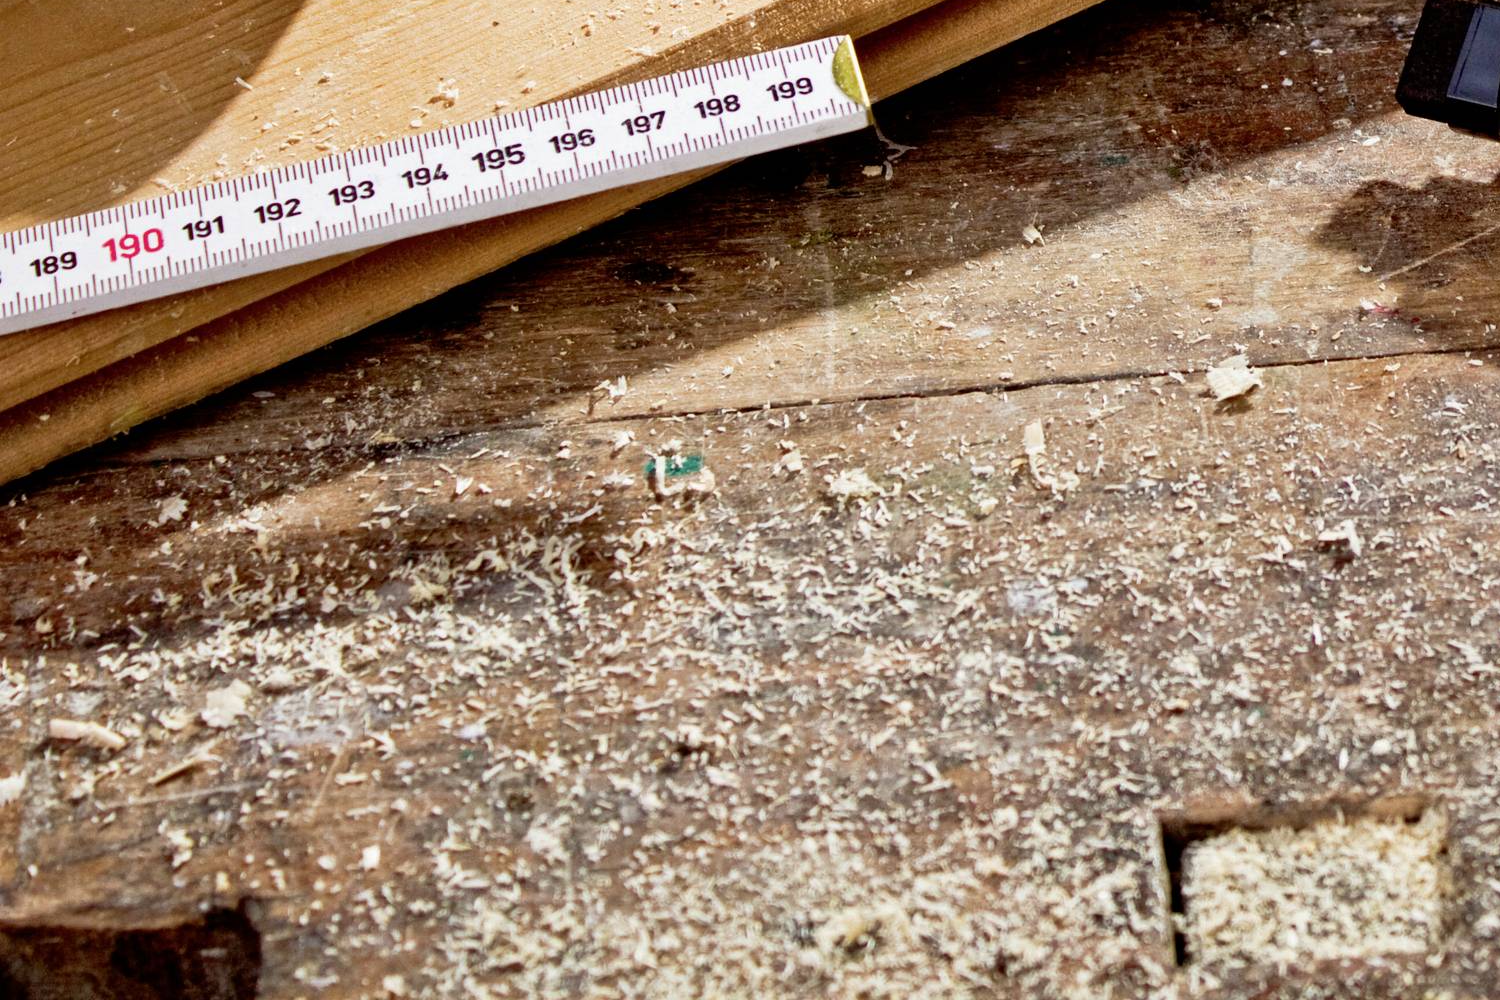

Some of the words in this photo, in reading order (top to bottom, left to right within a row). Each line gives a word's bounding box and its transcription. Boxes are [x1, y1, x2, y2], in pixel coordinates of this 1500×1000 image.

[30, 251, 78, 277] 189
[102, 228, 165, 262] 190
[182, 216, 225, 241] 191
[253, 198, 302, 224] 192
[328, 180, 376, 207] 193
[401, 164, 450, 189] 194
[471, 143, 526, 173] 195
[549, 129, 596, 154] 196
[621, 110, 666, 137] 197
[694, 94, 741, 119] 198
[766, 77, 814, 102] 199
